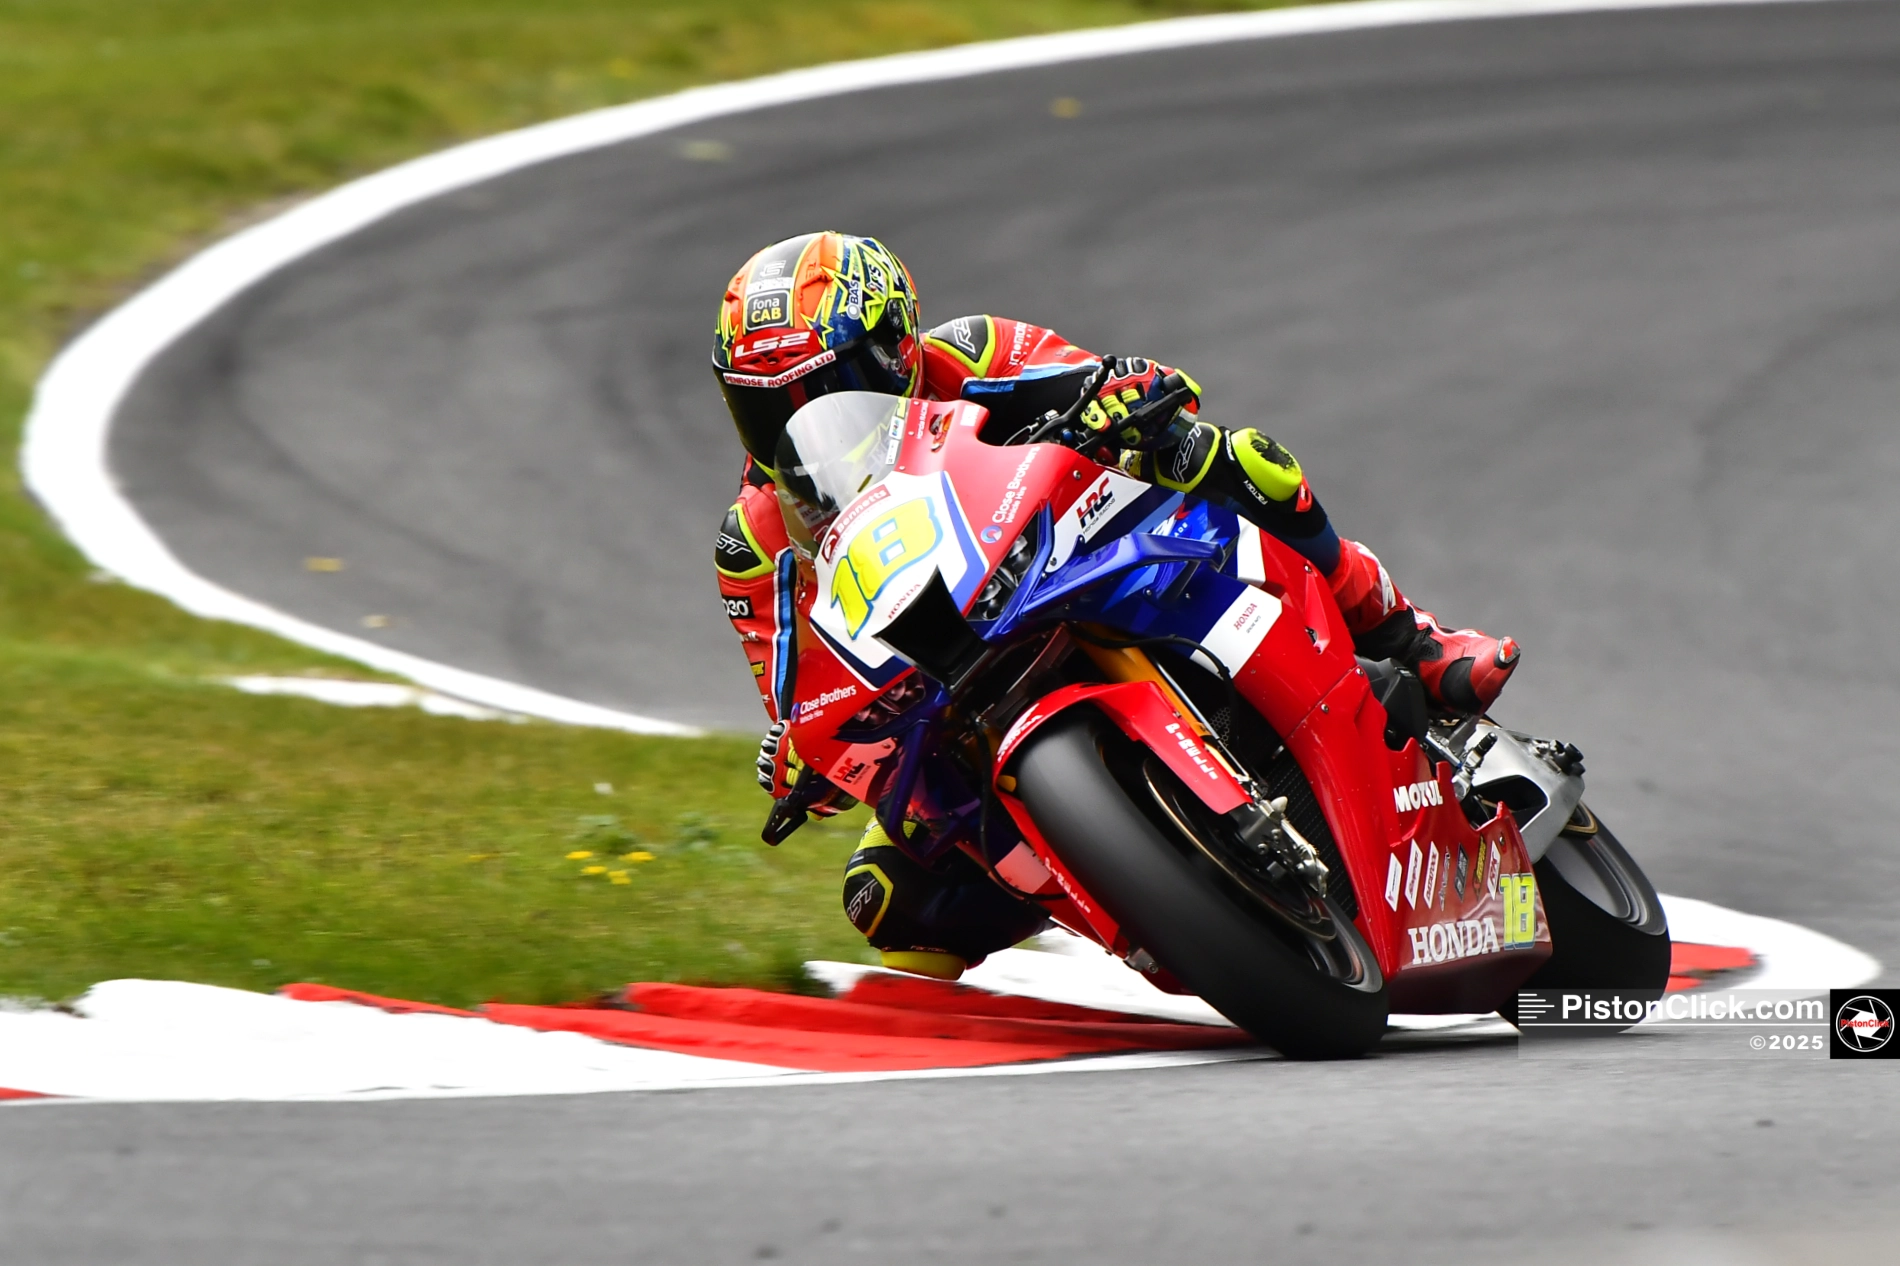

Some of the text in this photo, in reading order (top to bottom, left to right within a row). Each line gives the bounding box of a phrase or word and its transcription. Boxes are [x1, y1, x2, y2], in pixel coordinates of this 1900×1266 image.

[751, 307, 782, 323] CAB
[753, 298, 780, 310] fona
[735, 332, 810, 358] LS2
[725, 353, 834, 387] PENROSE ROOFING LTD
[1172, 423, 1202, 483] RST
[992, 446, 1041, 524] Close Brothers
[1243, 480, 1268, 505] FACTORY
[836, 489, 887, 533] Bennetts
[1005, 486, 1028, 524] Vehicle Hire
[1076, 476, 1113, 529] HRC
[1099, 498, 1116, 517] RACING
[716, 531, 752, 555] ST
[831, 497, 943, 640] 18
[888, 584, 921, 619] HONDA
[1233, 603, 1258, 630] HONDA
[800, 685, 857, 715] Close Brothers
[1165, 722, 1219, 780] PIRELLI
[1393, 780, 1443, 813] MOTUL
[1500, 873, 1535, 950] 18
[1407, 917, 1500, 965] HONDA
